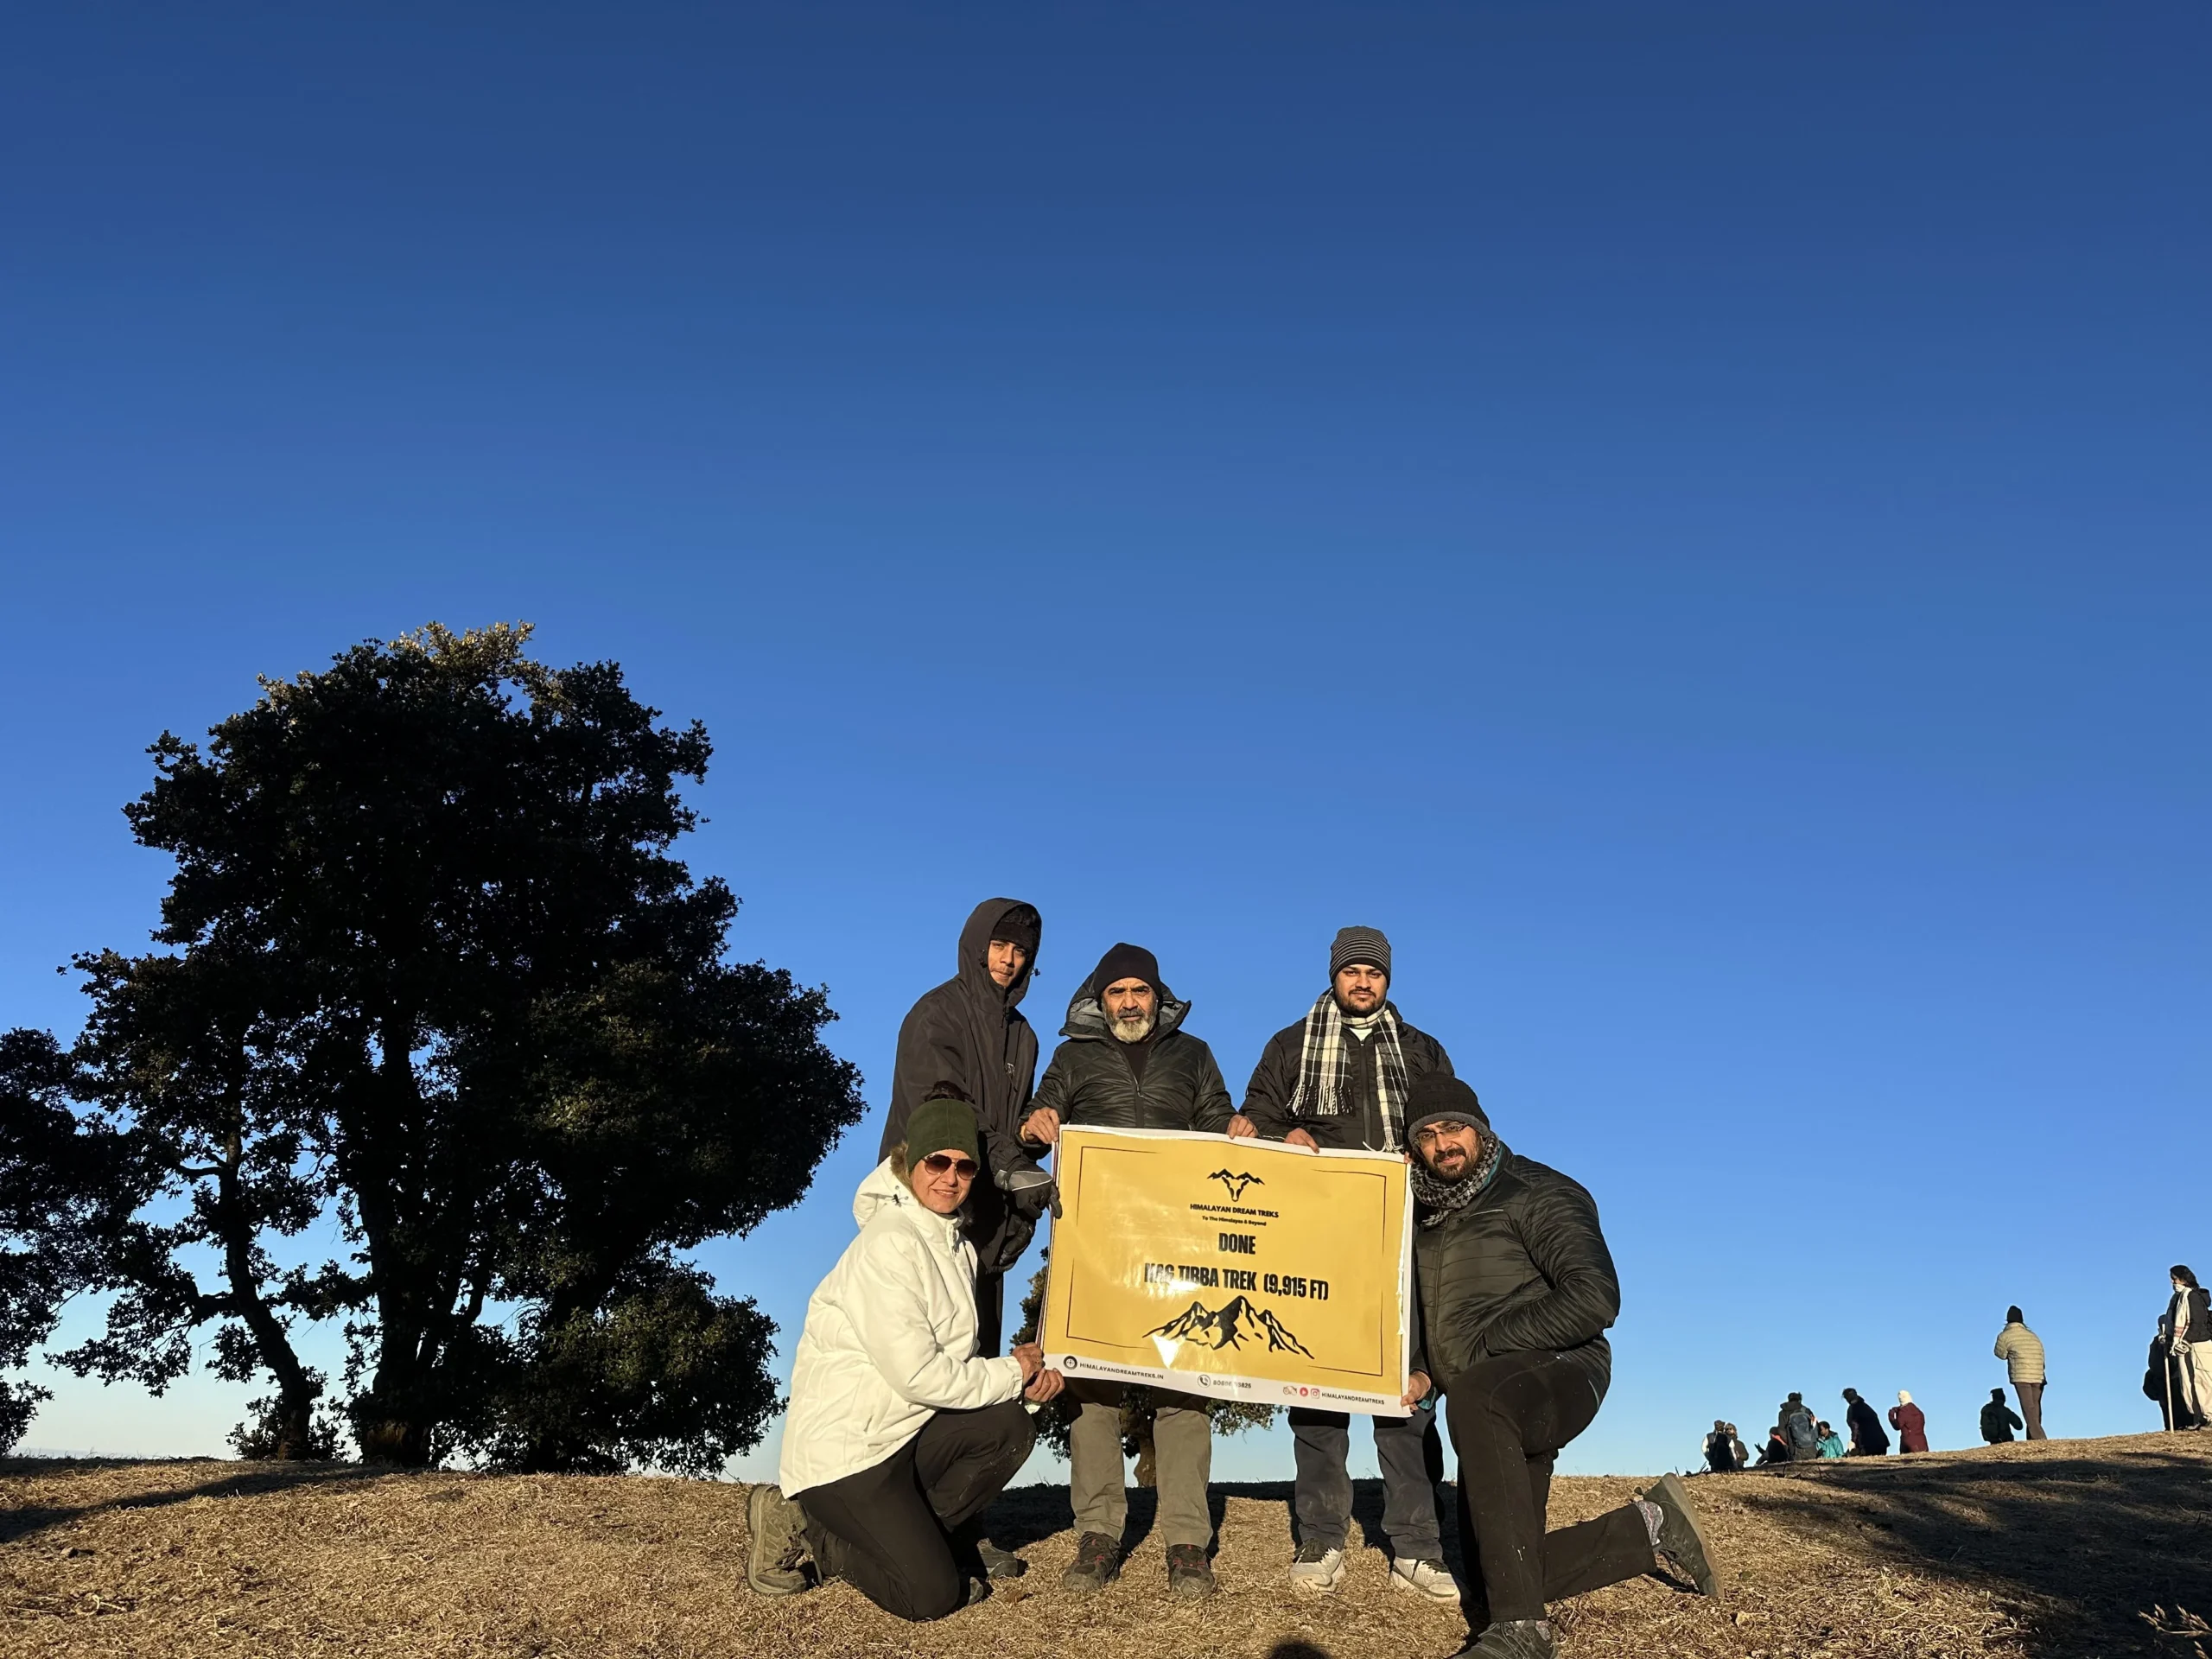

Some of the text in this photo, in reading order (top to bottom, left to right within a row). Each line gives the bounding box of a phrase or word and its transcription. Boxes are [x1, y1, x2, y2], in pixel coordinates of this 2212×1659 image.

[1190, 1204, 1230, 1213] HIMALAYAN
[1232, 1207, 1256, 1216] DREAM
[1218, 1233, 1256, 1255] DONE
[1178, 1265, 1219, 1287] TIBBA
[1222, 1268, 1257, 1291] TREK
[1263, 1273, 1306, 1298] (9,915
[1310, 1279, 1329, 1300] FT)
[1079, 1363, 1164, 1380] HIMALAYANDREAMTREKS.IN
[1321, 1392, 1385, 1405] HIMALAYANDREAMTREKS
